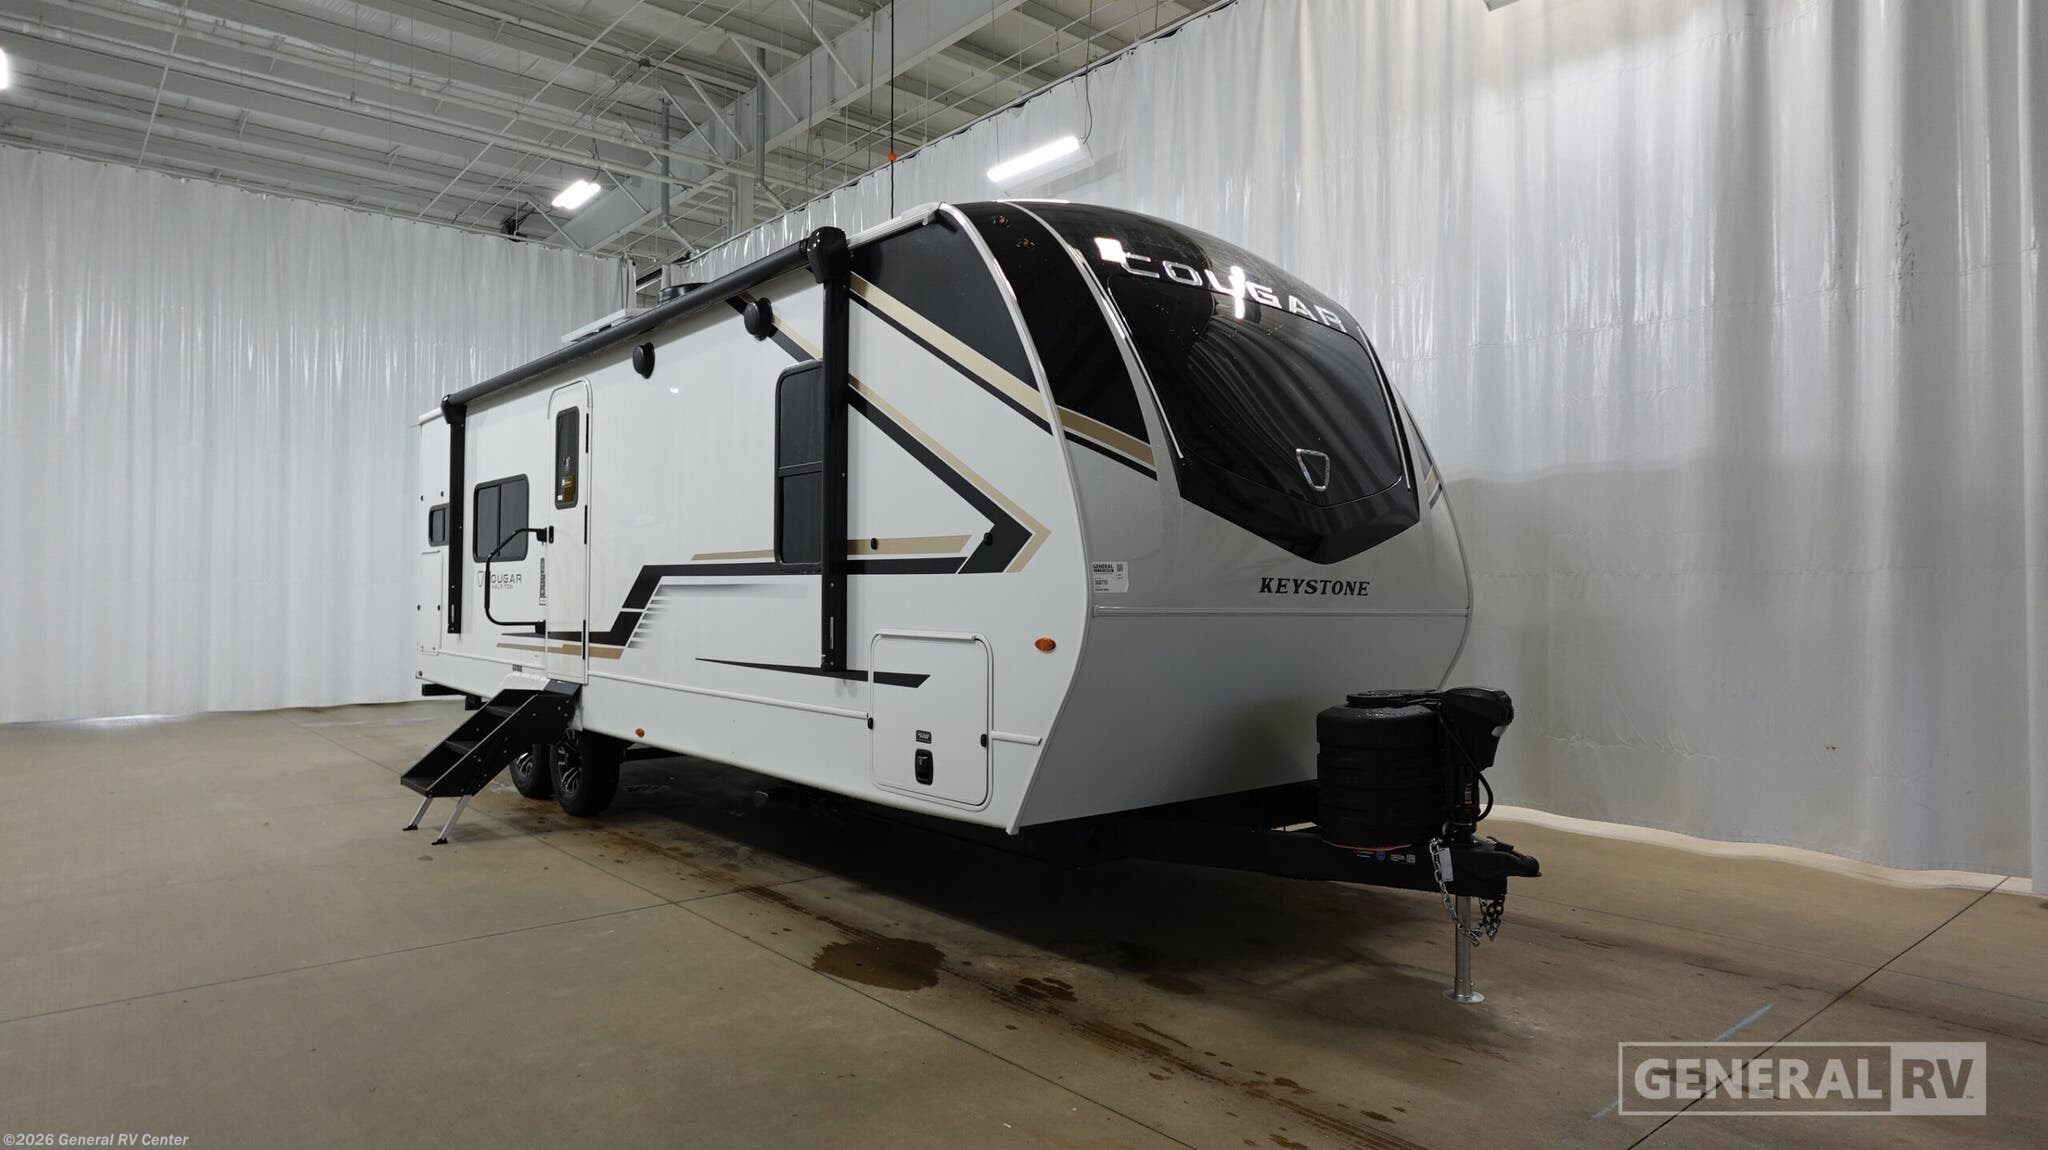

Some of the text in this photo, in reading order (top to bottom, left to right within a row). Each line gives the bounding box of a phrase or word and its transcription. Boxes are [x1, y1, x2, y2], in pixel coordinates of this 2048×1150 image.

[1120, 251, 1348, 333] COUGAR
[490, 574, 523, 584] OUGAR
[1258, 577, 1371, 597] KEYSTONE
